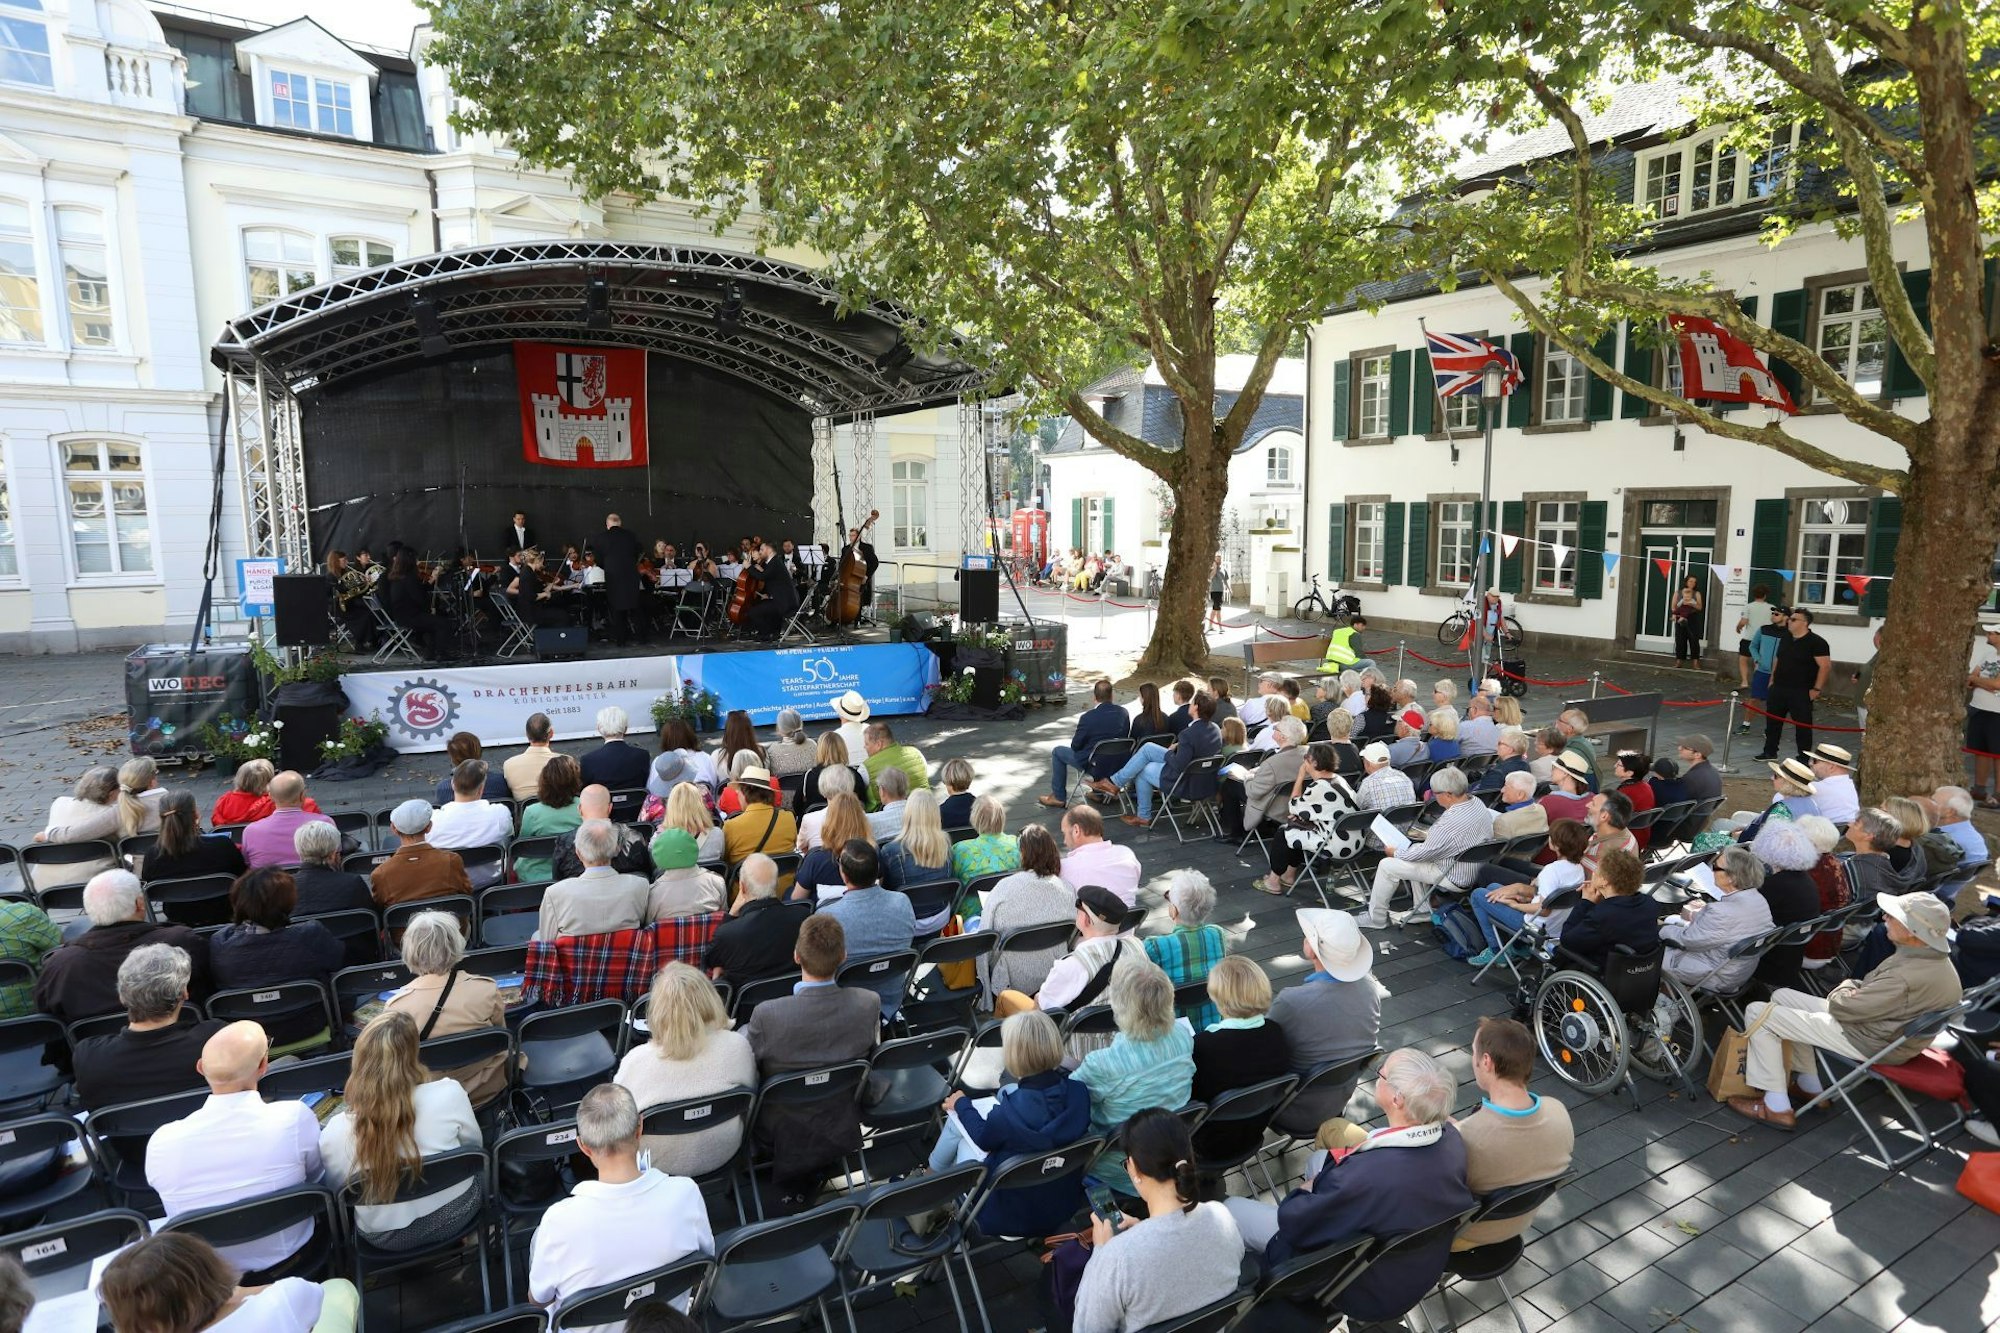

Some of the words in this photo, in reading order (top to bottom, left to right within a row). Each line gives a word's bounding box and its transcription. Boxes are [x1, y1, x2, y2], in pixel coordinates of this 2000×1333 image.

[780, 677, 804, 685] YEARS
[781, 681, 860, 693] STÄDTEPARTNERSCHAFT
[473, 680, 638, 698] DRACHENFELSBAHN
[514, 692, 608, 705] KÖNIGSWINTER
[545, 707, 561, 715] Seit
[562, 706, 581, 714] 1883
